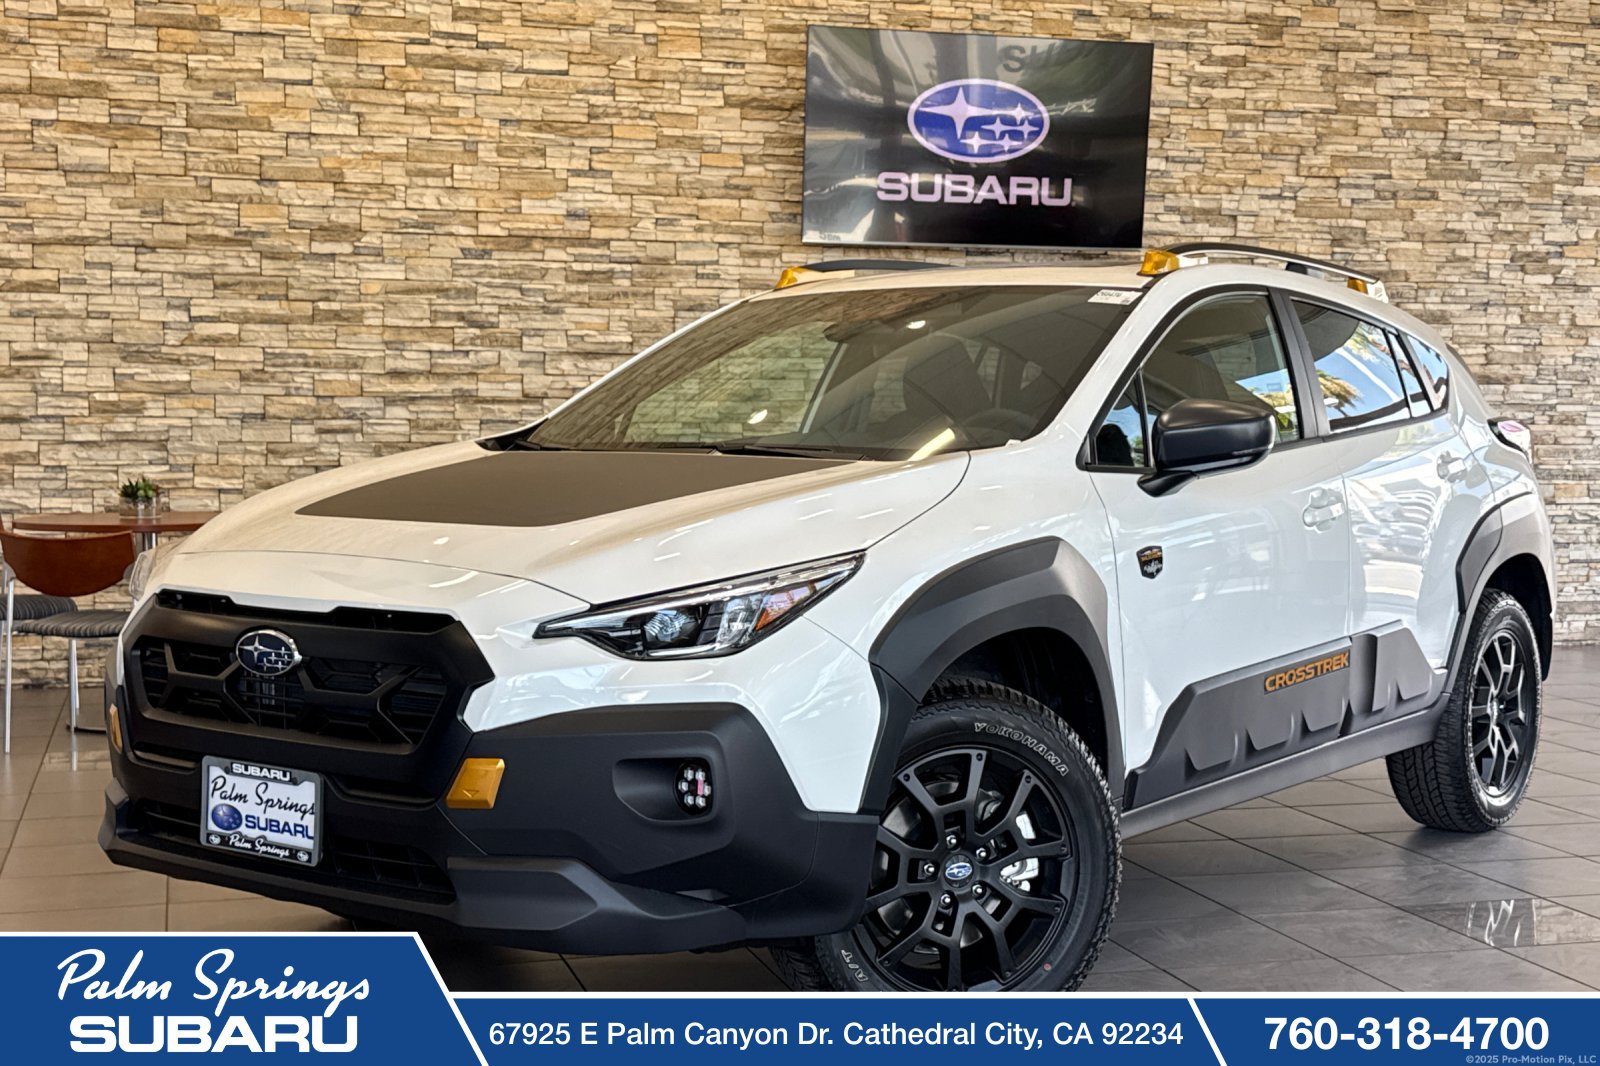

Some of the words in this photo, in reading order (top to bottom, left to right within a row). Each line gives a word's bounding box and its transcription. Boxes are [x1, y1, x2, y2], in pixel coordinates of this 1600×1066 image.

[876, 171, 1073, 207] SUBARU
[1265, 651, 1349, 692] CROSSTREK
[974, 722, 1069, 777] YOKOHAMA
[231, 763, 291, 782] SUBARU
[211, 775, 249, 803] Palm
[255, 781, 315, 822] Springs
[229, 833, 252, 849] Palm
[254, 838, 290, 861] Springs
